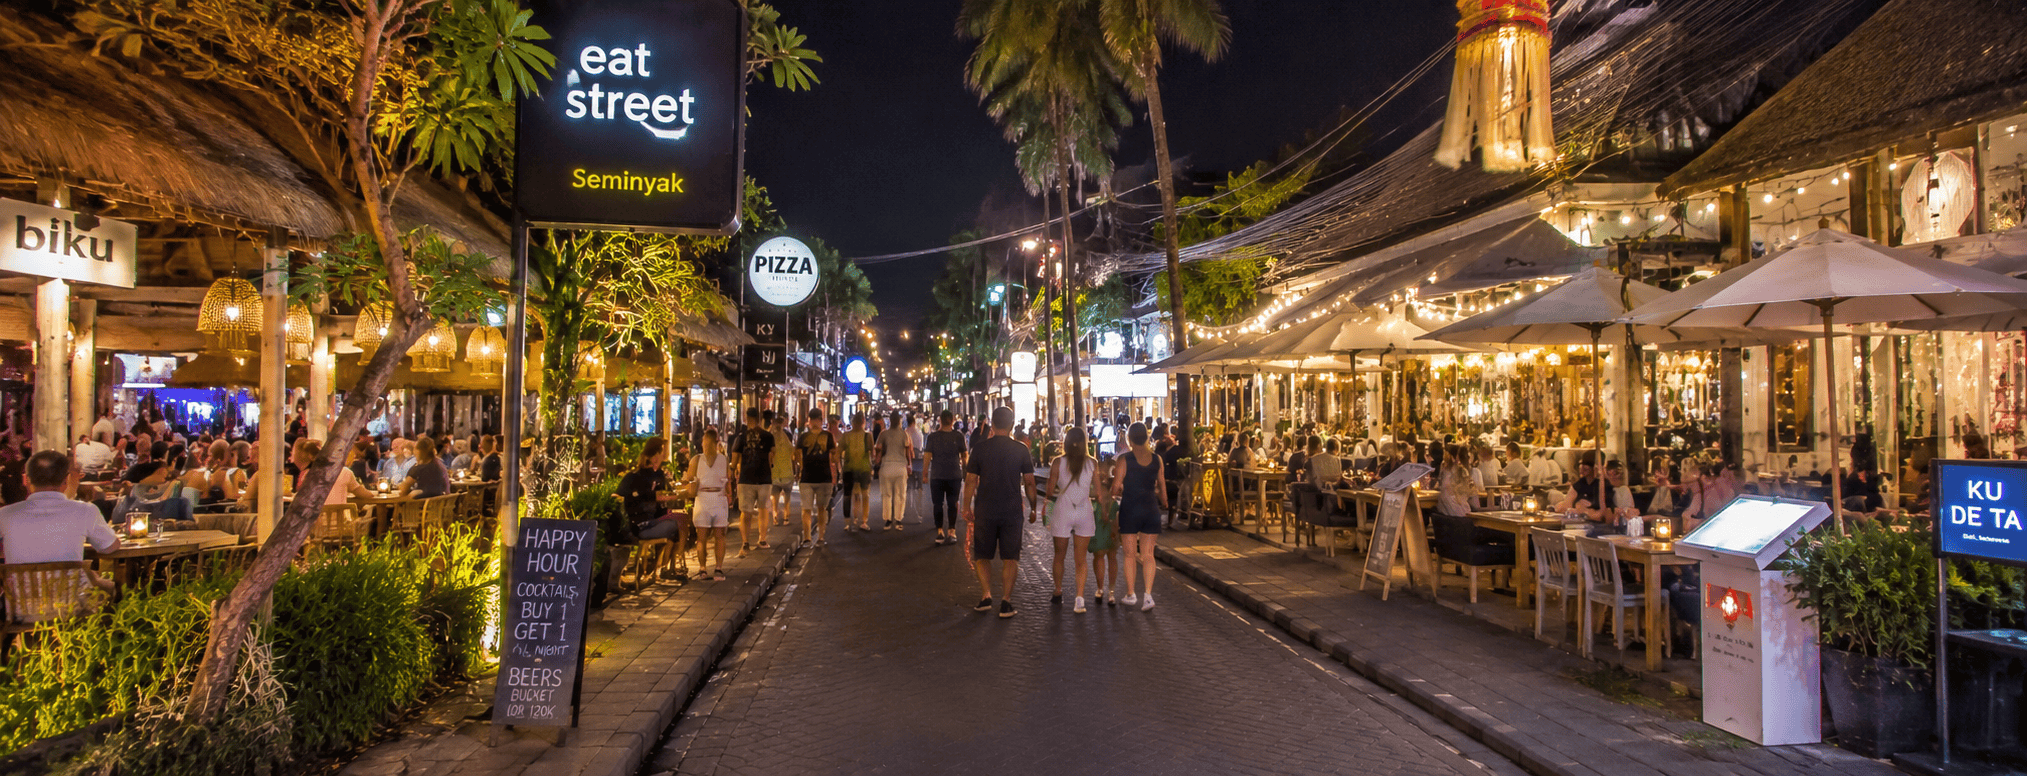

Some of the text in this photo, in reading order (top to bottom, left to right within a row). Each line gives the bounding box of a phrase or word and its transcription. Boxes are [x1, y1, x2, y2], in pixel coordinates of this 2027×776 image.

[580, 43, 651, 77] eat
[565, 83, 695, 125] street
[572, 168, 684, 196] Seminyak
[16, 214, 114, 263] biku
[755, 255, 813, 275] PIZZA
[1967, 480, 2003, 501] KU
[1951, 505, 2023, 530] DE TA
[525, 528, 587, 552] HAPPY
[526, 552, 579, 575] HOUR
[521, 601, 567, 620] BUY 1
[514, 622, 566, 641] GET 1
[508, 667, 562, 687] BEERS
